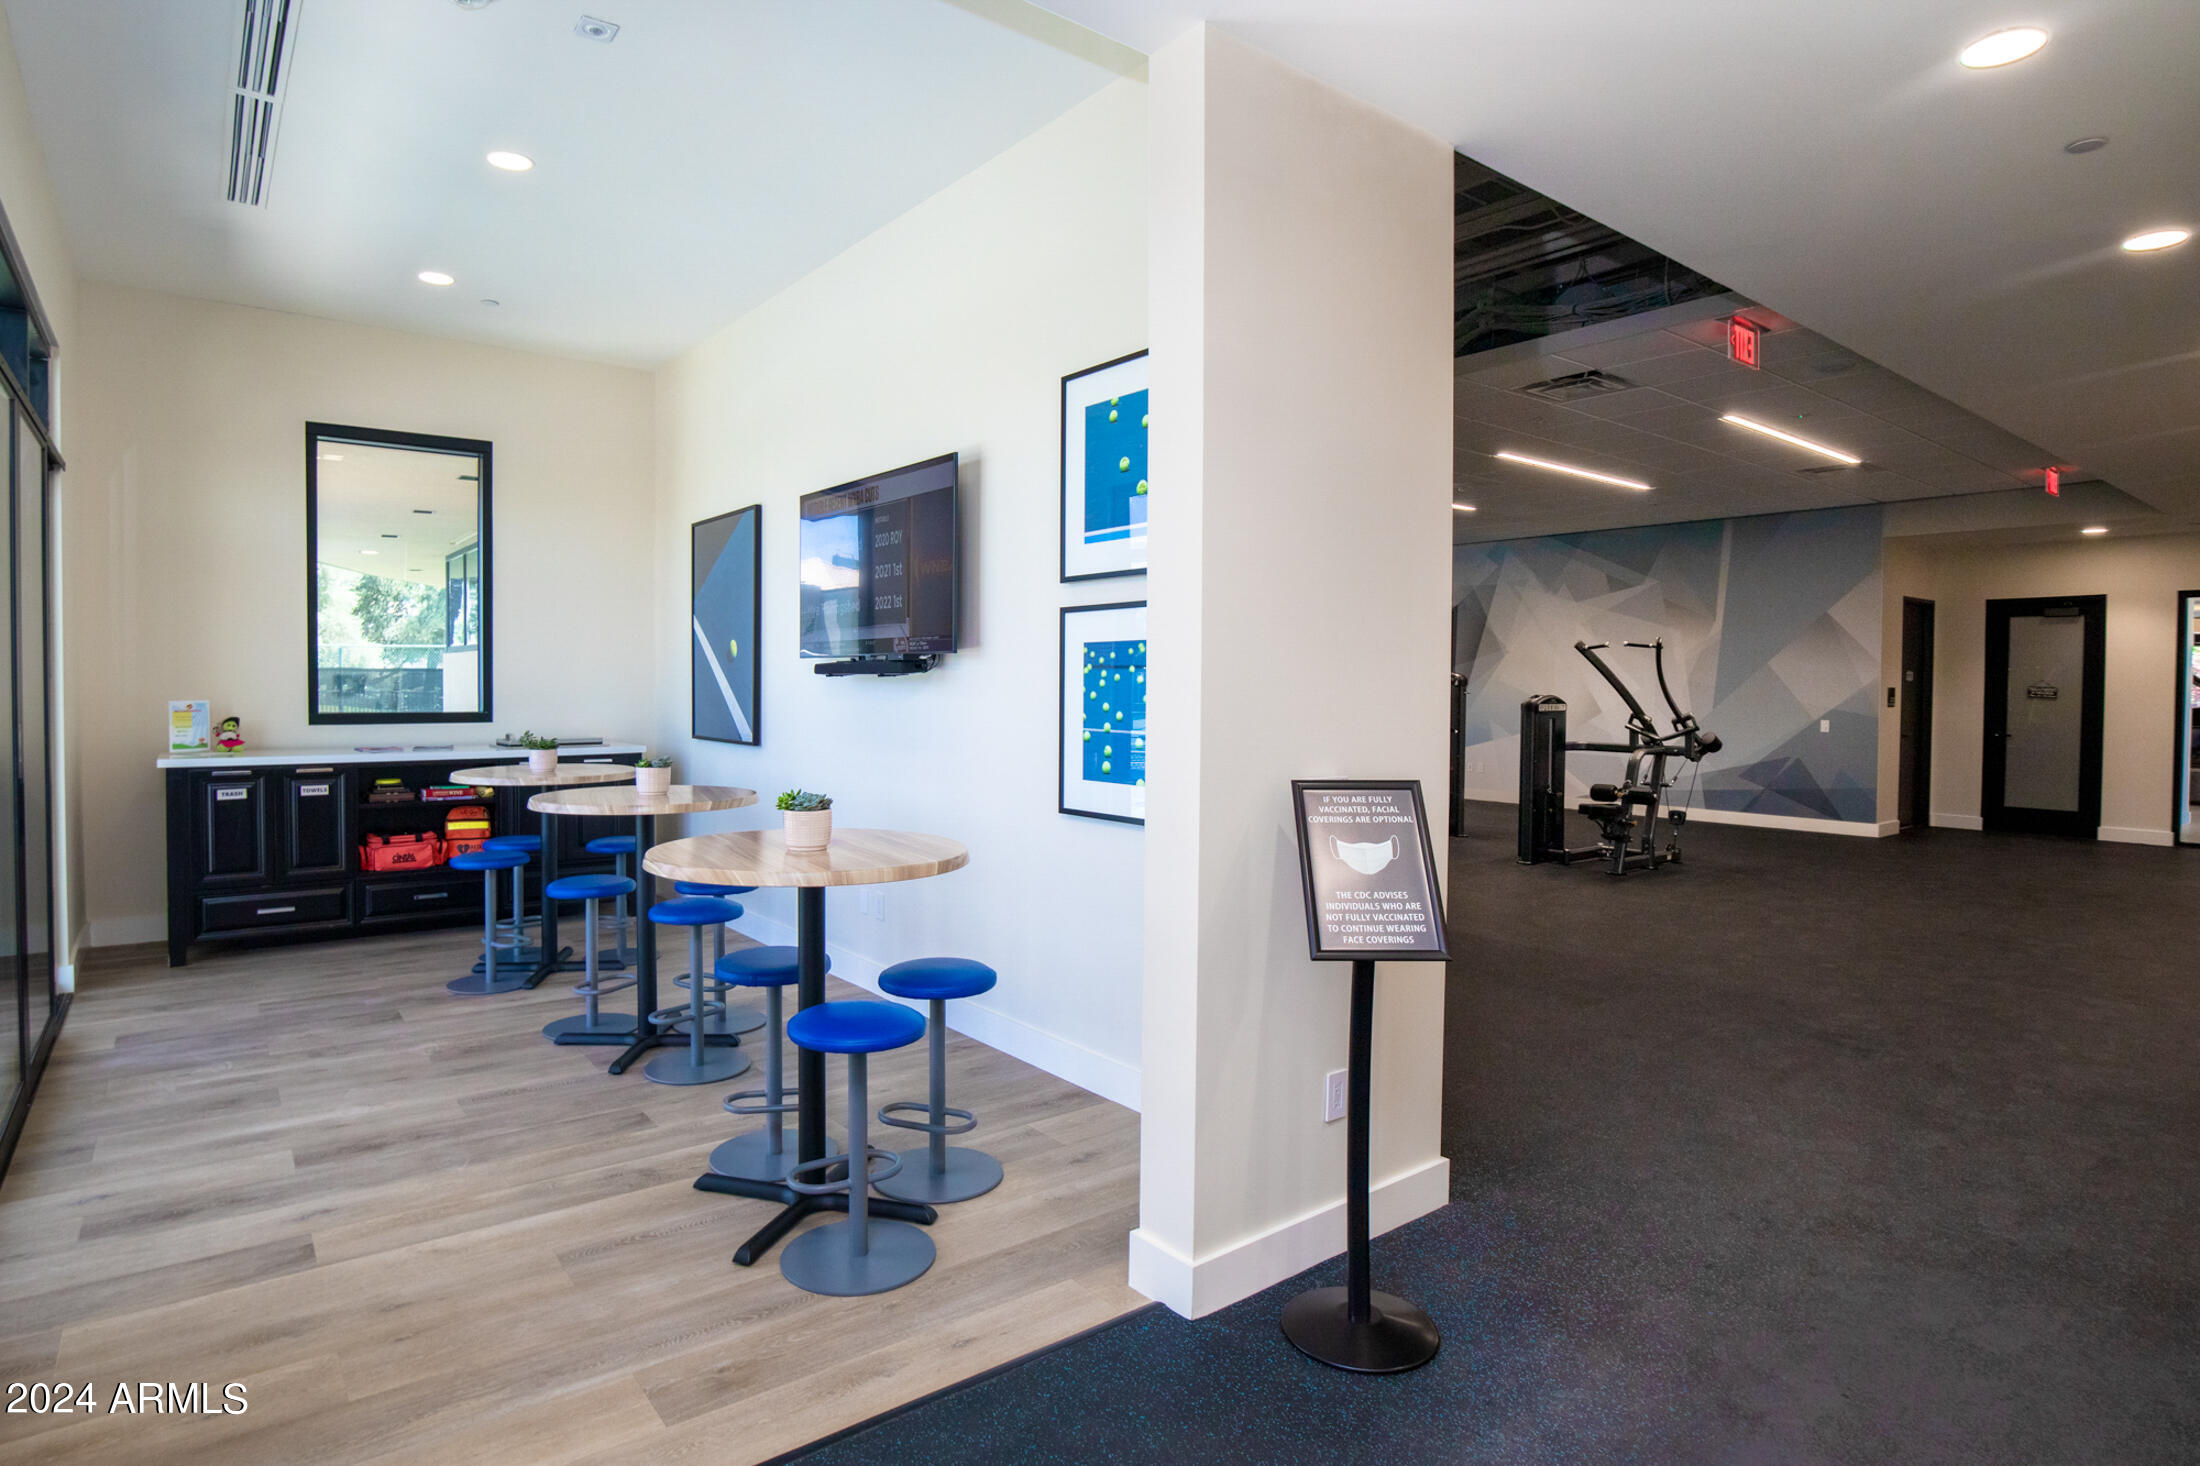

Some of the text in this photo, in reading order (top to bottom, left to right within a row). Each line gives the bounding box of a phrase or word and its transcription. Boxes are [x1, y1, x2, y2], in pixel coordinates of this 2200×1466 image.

[875, 529, 902, 548] 2020 ROY
[875, 562, 902, 579] 2021 1st
[875, 595, 891, 610] 2022
[893, 594, 902, 608] 1st
[1319, 806, 1370, 814] VACCINATED,
[1336, 891, 1408, 899] THE CDC ADVISES
[1326, 902, 1422, 910] INDIVIDUALS WHO ARE
[1326, 913, 1425, 921] NOT FULLY VACCINATED
[1328, 924, 1427, 932] TO CONTINUE WEARING
[1343, 935, 1415, 944] FACE COVERINGS
